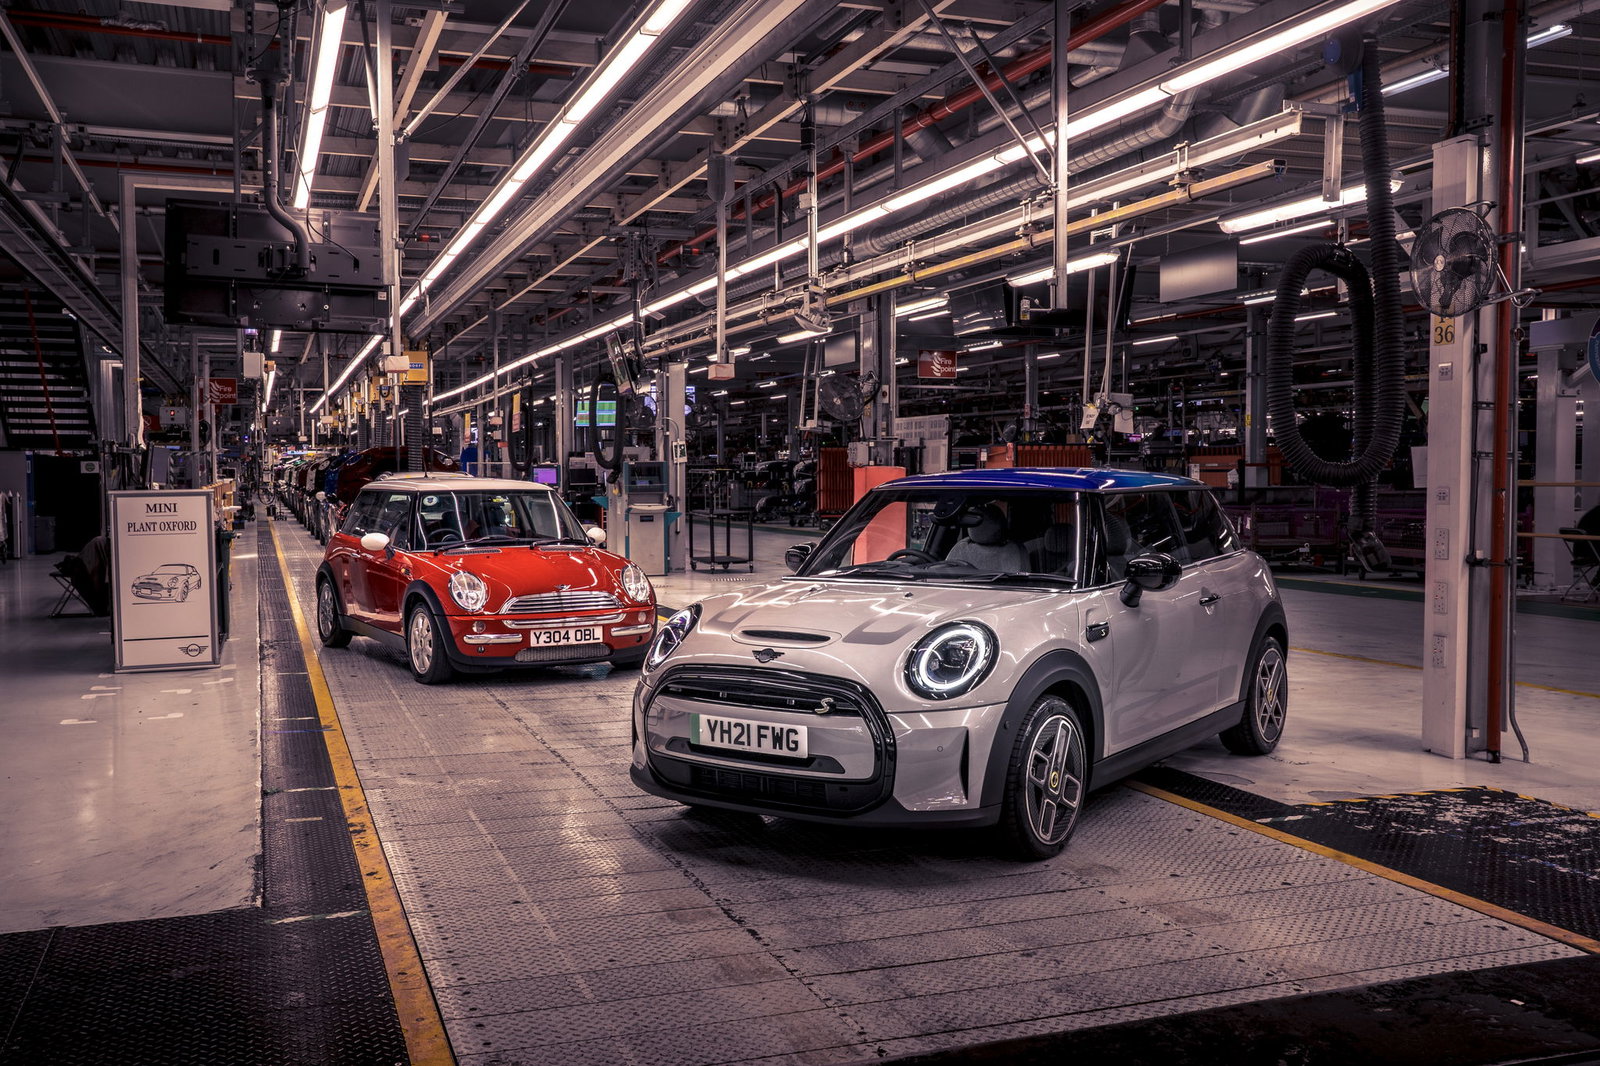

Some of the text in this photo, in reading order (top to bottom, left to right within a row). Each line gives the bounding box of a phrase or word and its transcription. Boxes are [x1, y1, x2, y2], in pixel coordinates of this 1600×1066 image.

[1434, 325, 1454, 344] 36
[145, 503, 178, 514] MINI
[127, 520, 197, 533] PLANT OXFORD
[533, 628, 600, 644] Y304 OBL
[706, 718, 799, 752] YH21 FWG
